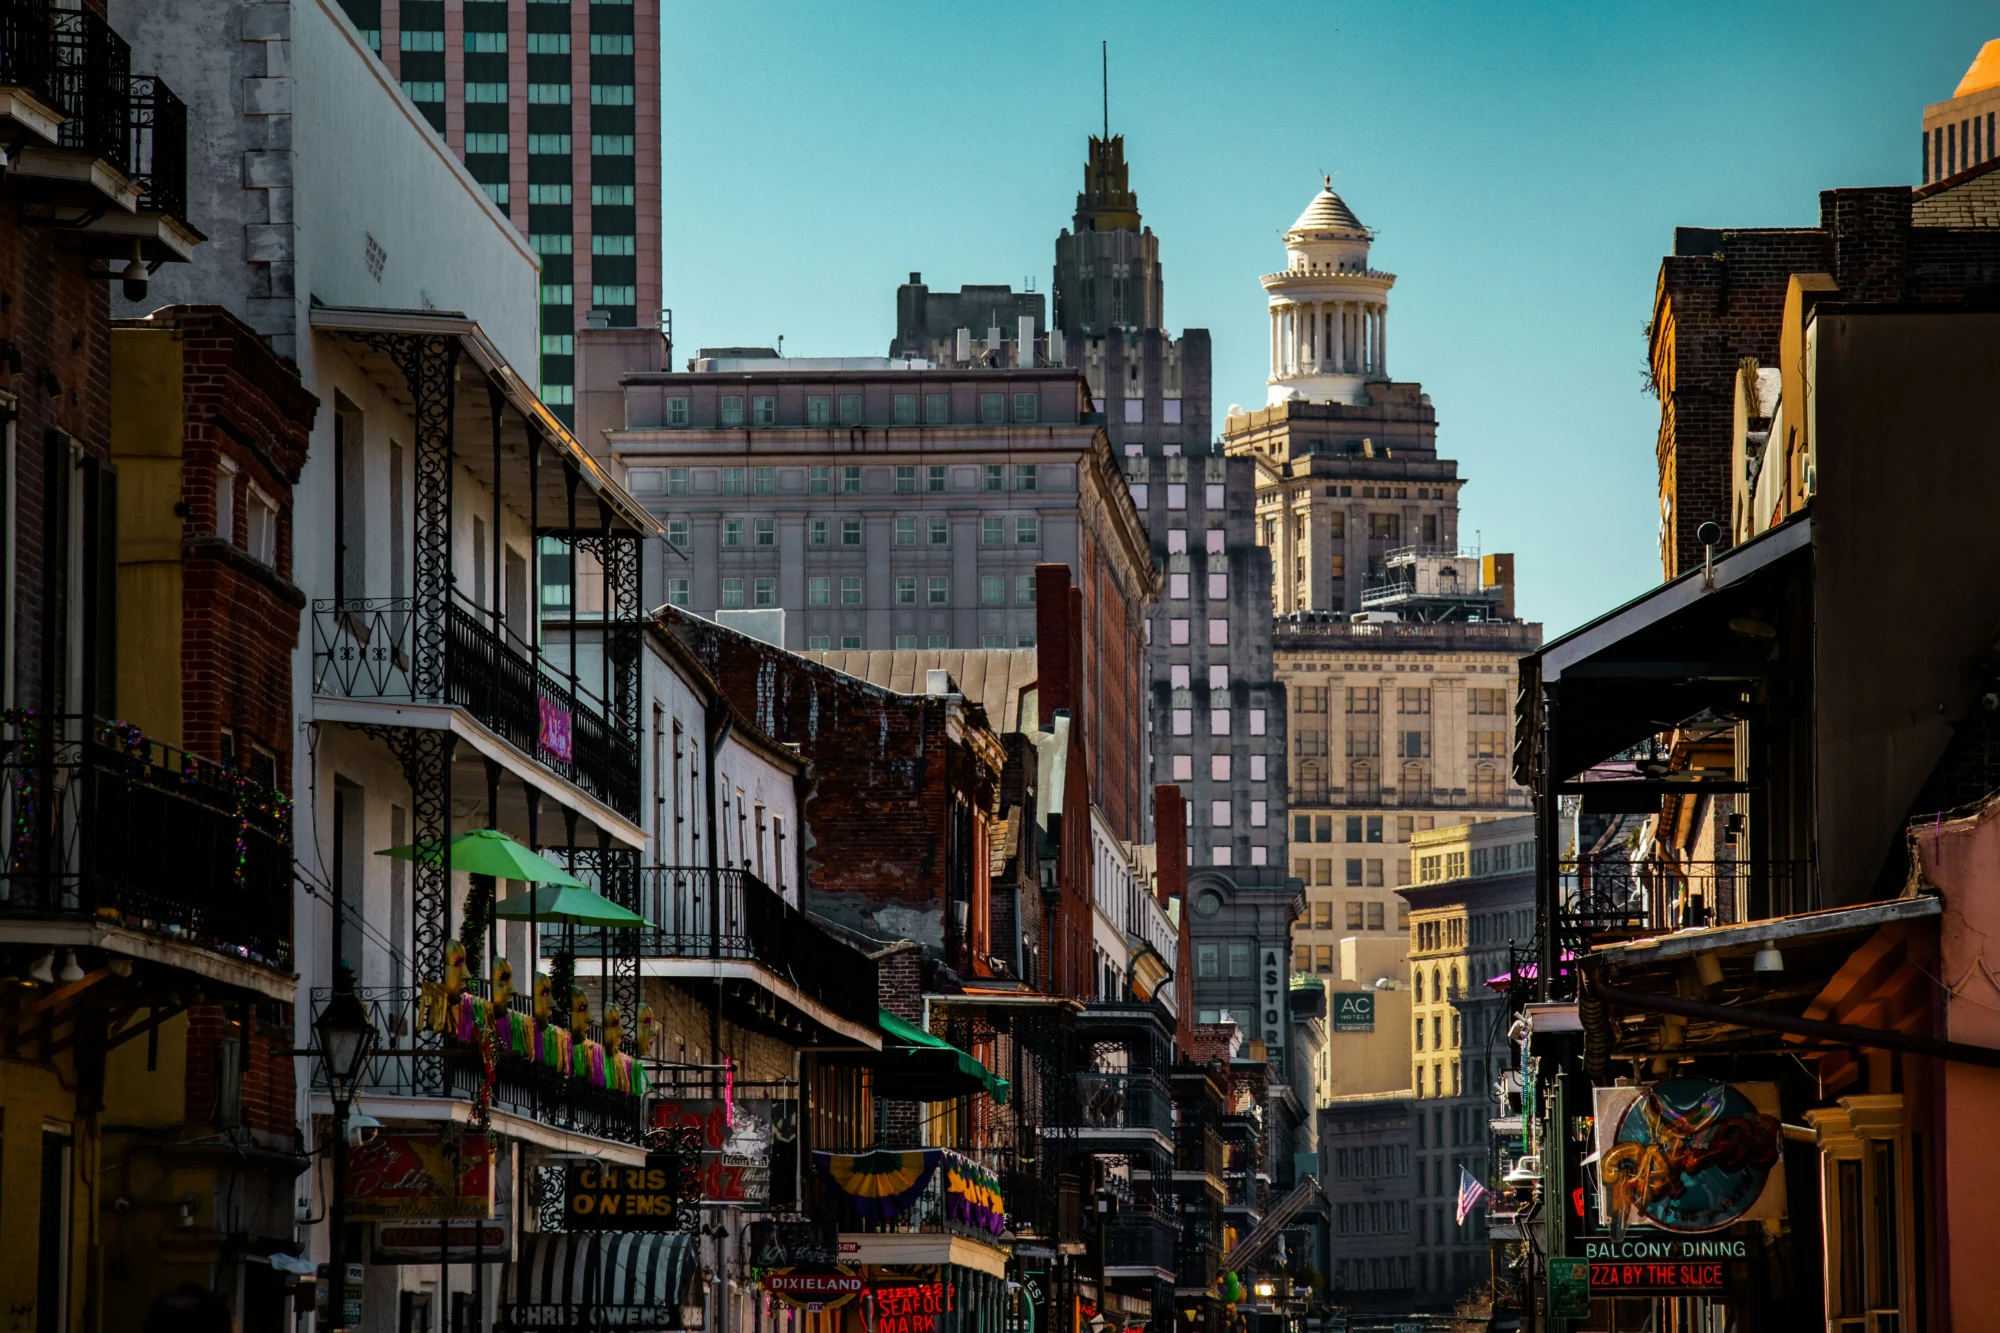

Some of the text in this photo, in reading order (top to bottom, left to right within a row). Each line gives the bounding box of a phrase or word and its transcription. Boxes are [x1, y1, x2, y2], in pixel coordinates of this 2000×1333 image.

[1266, 951, 1278, 1044] ASTOR
[1341, 997, 1370, 1013] AC
[579, 1168, 666, 1191] CHRIS
[572, 1194, 673, 1216] OWENS
[1586, 1241, 1746, 1258] BALCONY DINING
[1623, 1266, 1643, 1285] BY
[1646, 1265, 1677, 1285] THE
[1681, 1265, 1723, 1285] SLICE
[772, 1278, 862, 1291] DIXIELAND
[876, 1286, 920, 1300] PIER
[510, 1304, 671, 1327] CHRIS OWENS
[808, 1303, 824, 1311] ATM
